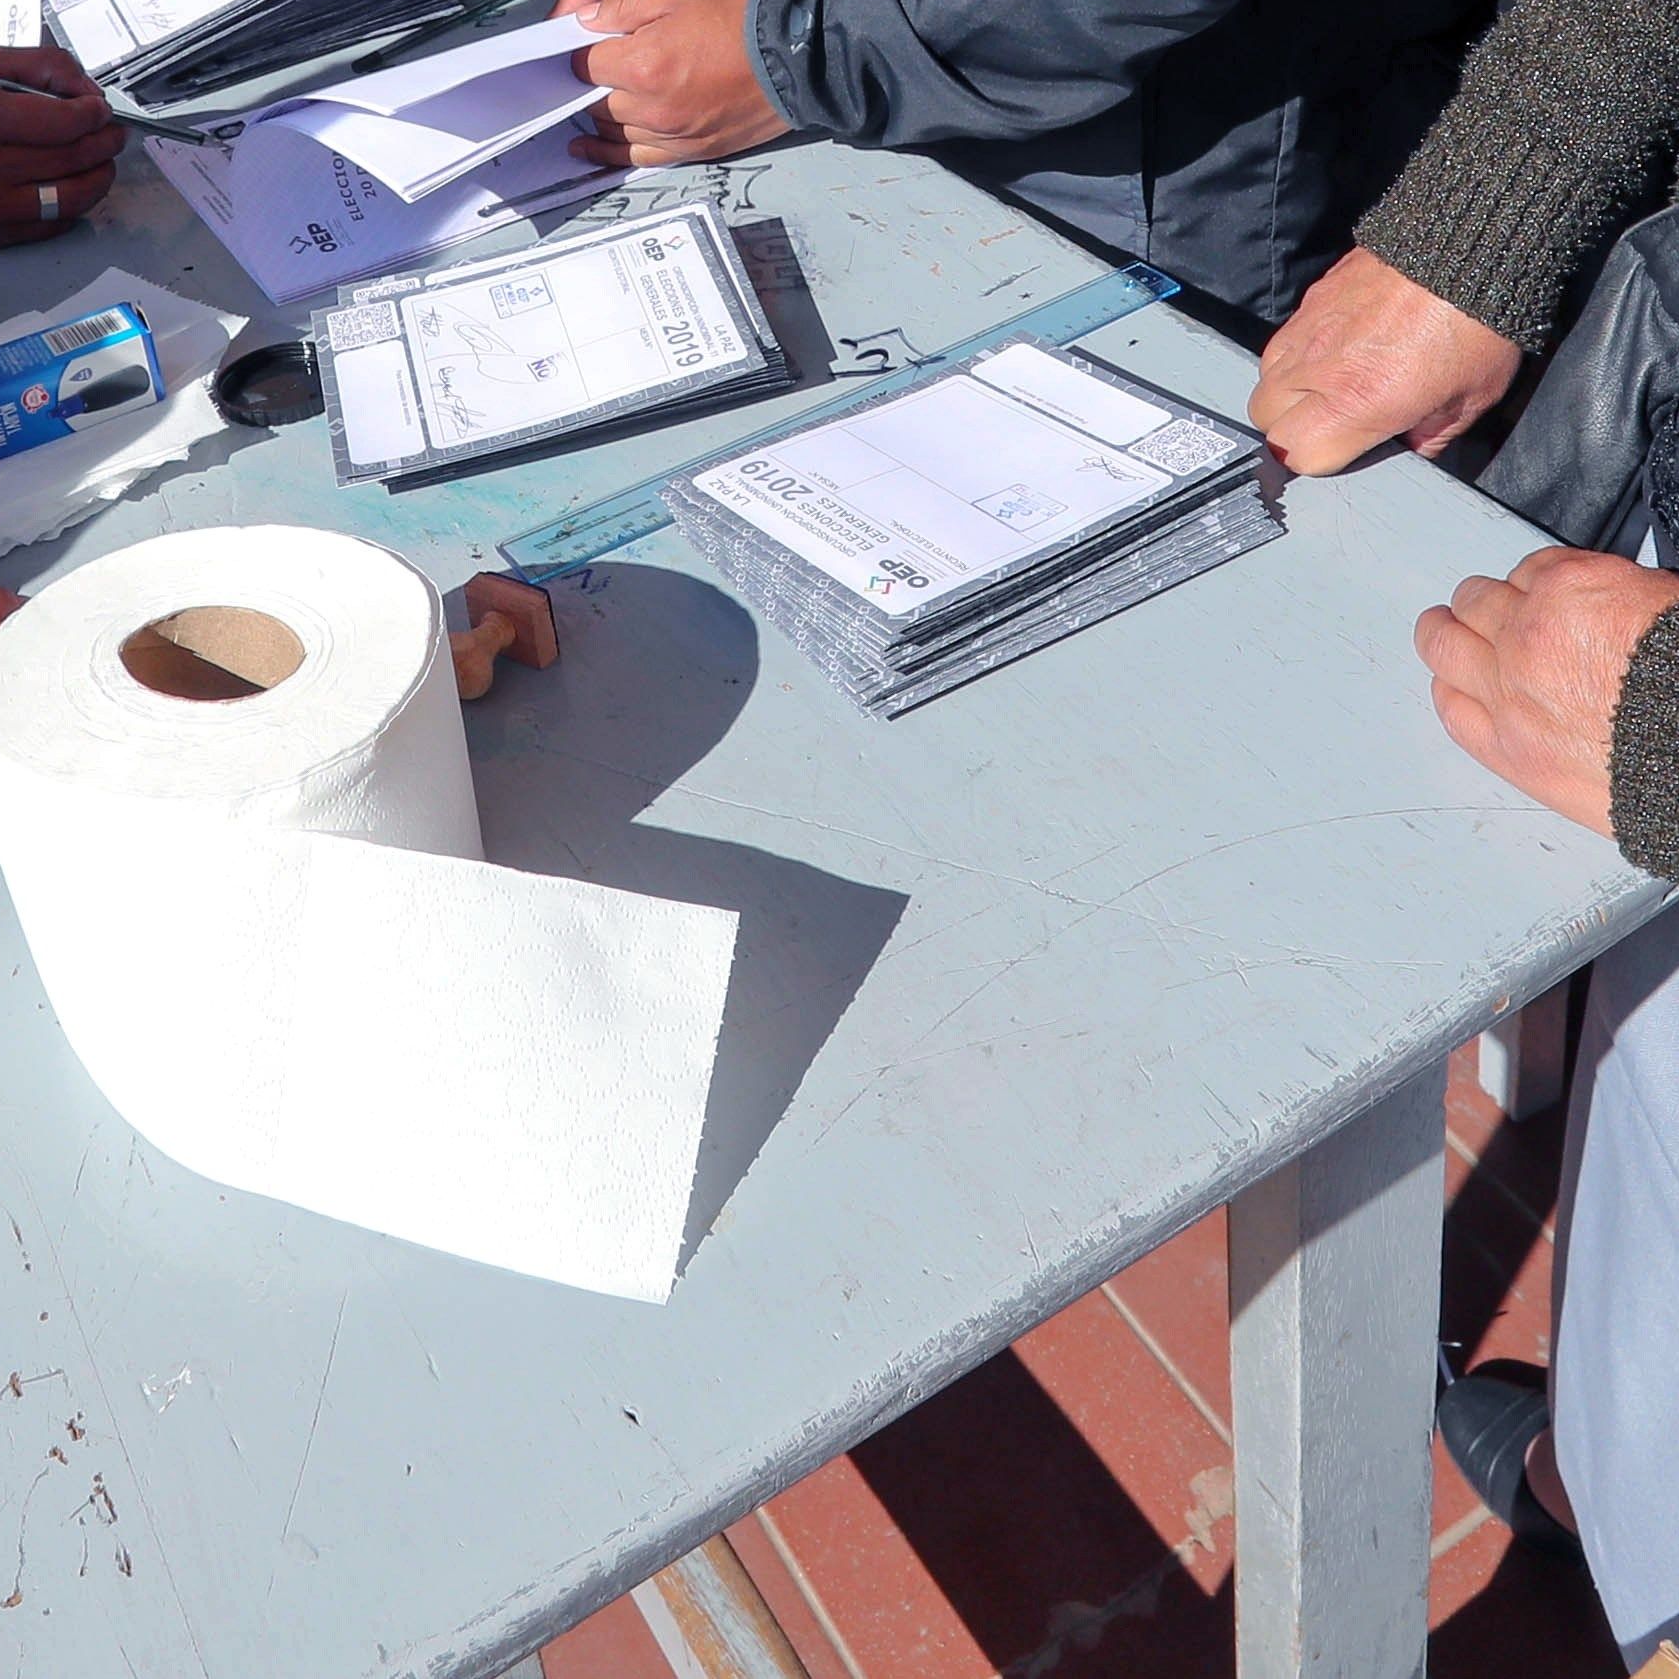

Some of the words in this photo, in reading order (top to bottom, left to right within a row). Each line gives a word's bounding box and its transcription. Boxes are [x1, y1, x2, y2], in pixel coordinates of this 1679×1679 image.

[360, 180, 377, 199] 20
[306, 222, 338, 253] OEP
[641, 237, 666, 262] OEP
[640, 274, 669, 321] GENERALES
[656, 269, 686, 319] ELECCIONES
[661, 321, 704, 367] 2019
[714, 323, 729, 338] LA
[720, 336, 737, 354] PAZ
[708, 478, 732, 501] PAZ
[735, 477, 785, 514] UNINOMINAL
[739, 460, 814, 501] 2019
[731, 491, 753, 507] LA
[797, 501, 875, 553] ELECCIONES
[816, 496, 891, 545] GENERALES
[889, 518, 936, 552] ELECTORAL
[878, 557, 931, 589] OEP
[931, 544, 970, 571] RECINTO
